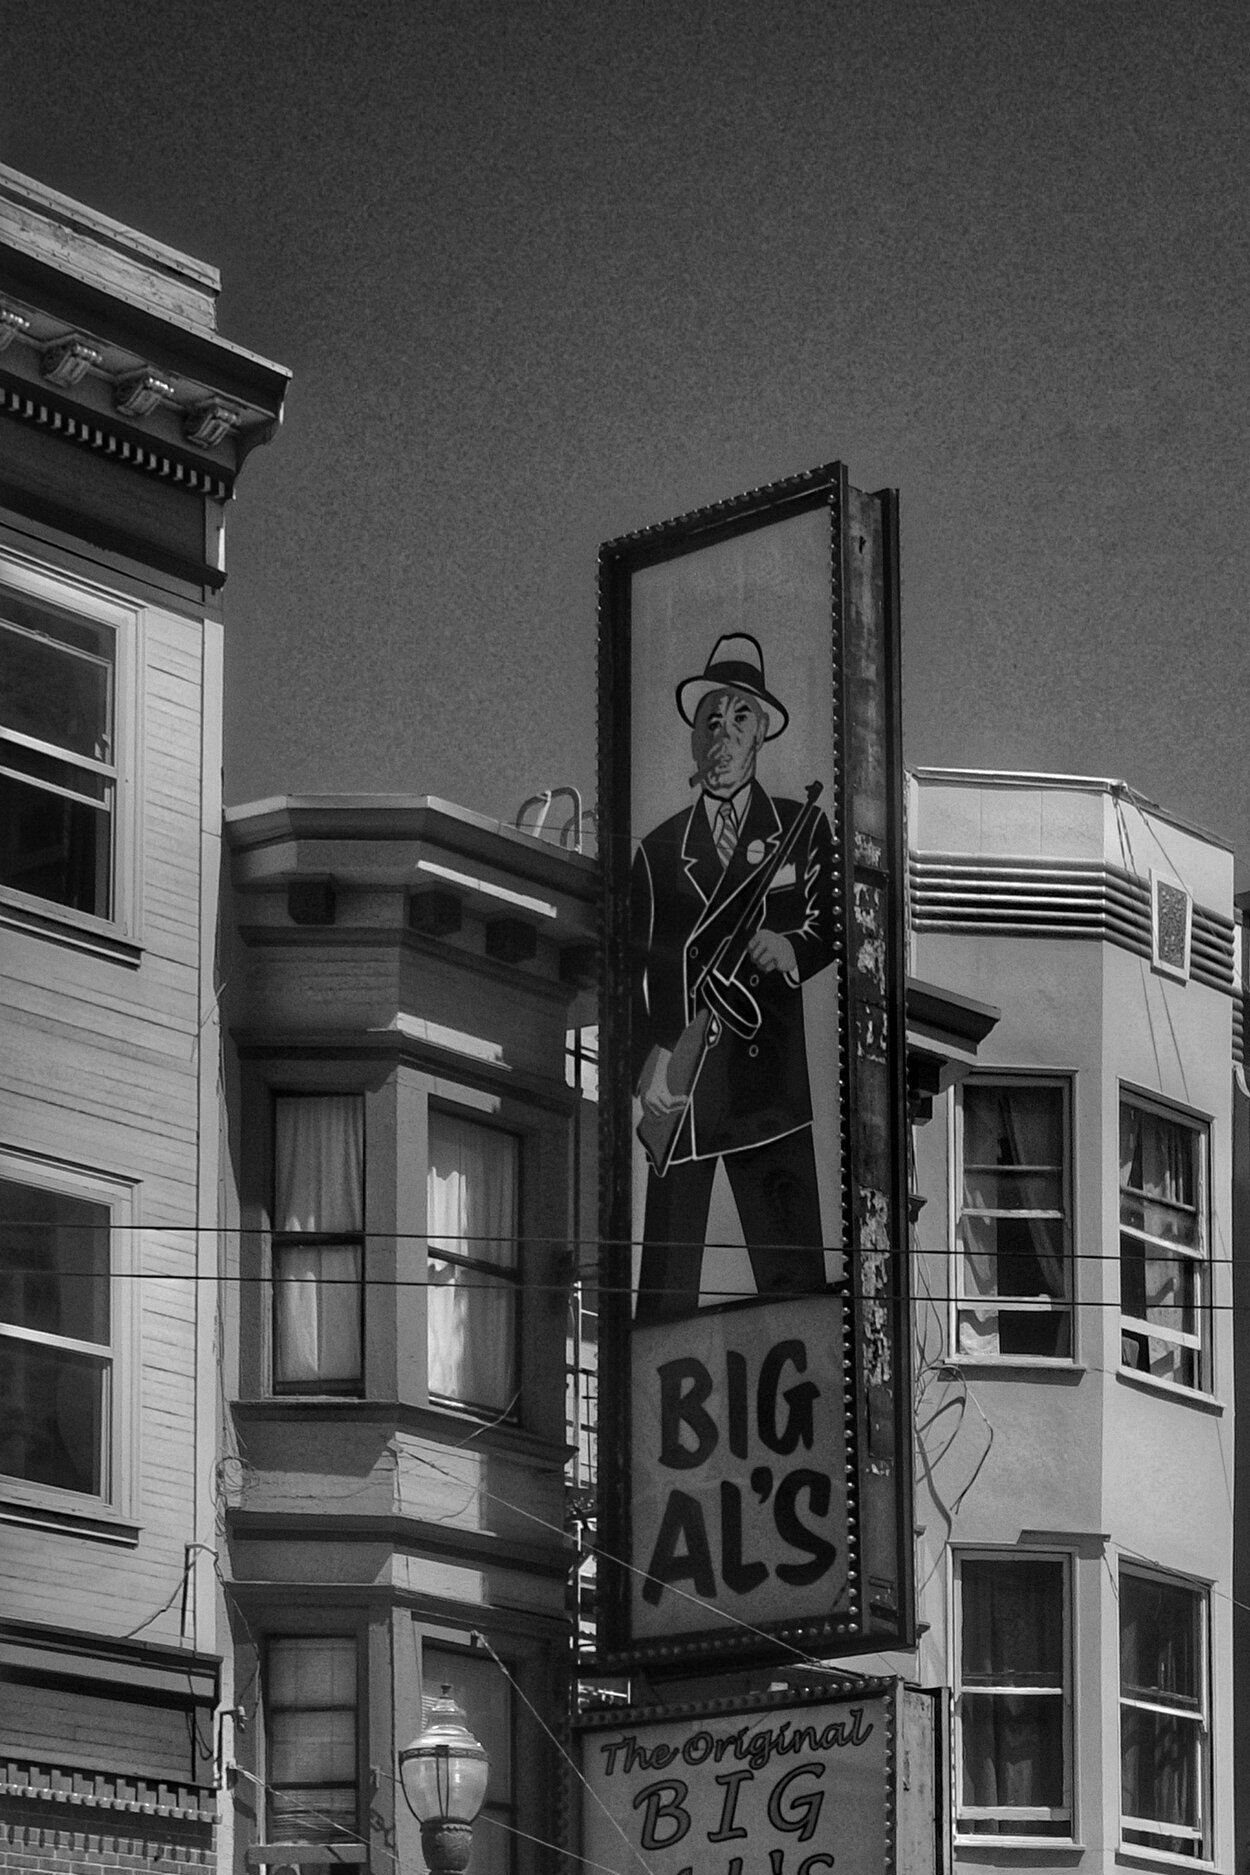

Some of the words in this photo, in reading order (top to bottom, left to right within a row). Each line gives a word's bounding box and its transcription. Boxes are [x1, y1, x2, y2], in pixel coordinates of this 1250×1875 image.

[656, 1339, 820, 1470] BIG
[642, 1466, 836, 1605] AL'S
[601, 1737, 680, 1776] The
[681, 1708, 873, 1770] Original
[633, 1762, 826, 1850] BIG
